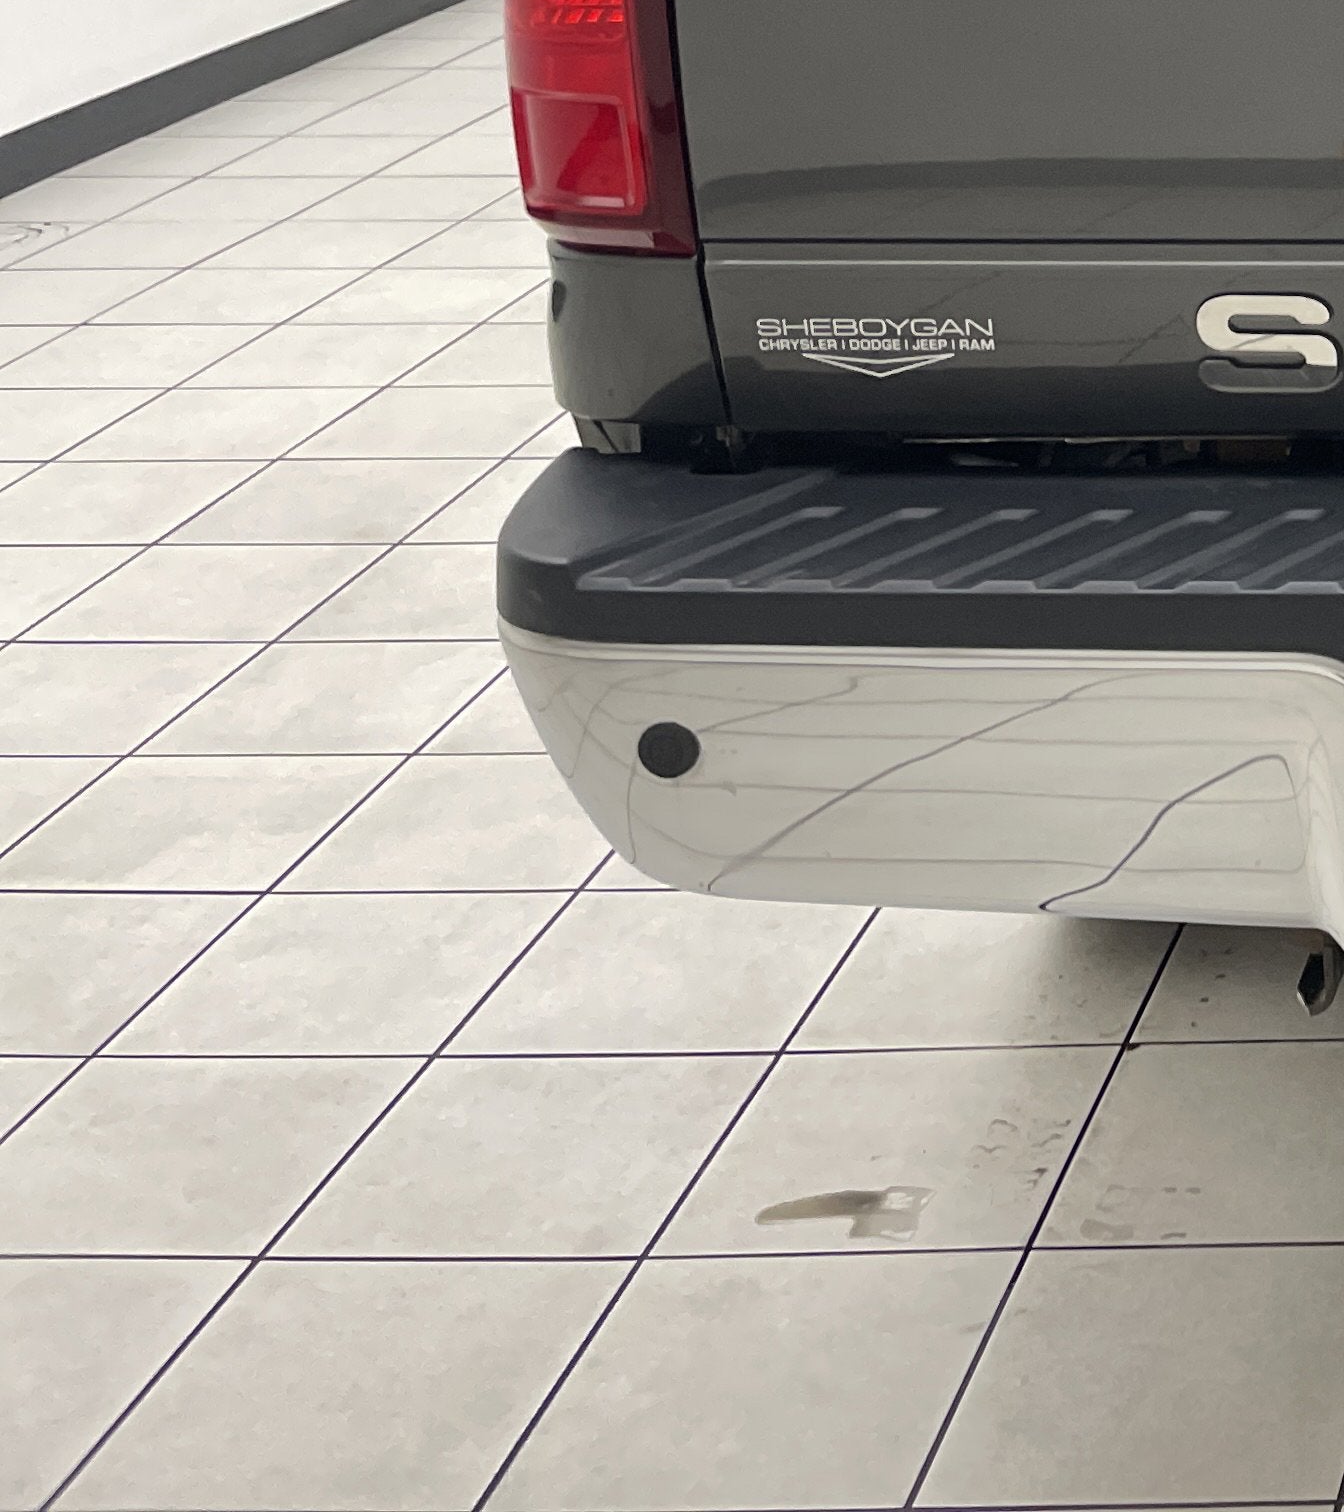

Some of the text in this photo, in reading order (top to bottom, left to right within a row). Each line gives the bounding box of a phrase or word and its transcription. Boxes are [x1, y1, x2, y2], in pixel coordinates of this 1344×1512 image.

[756, 318, 994, 337] SHEBOYGAN
[758, 339, 996, 351] CHRYSLER DODGE JEEP RAM
